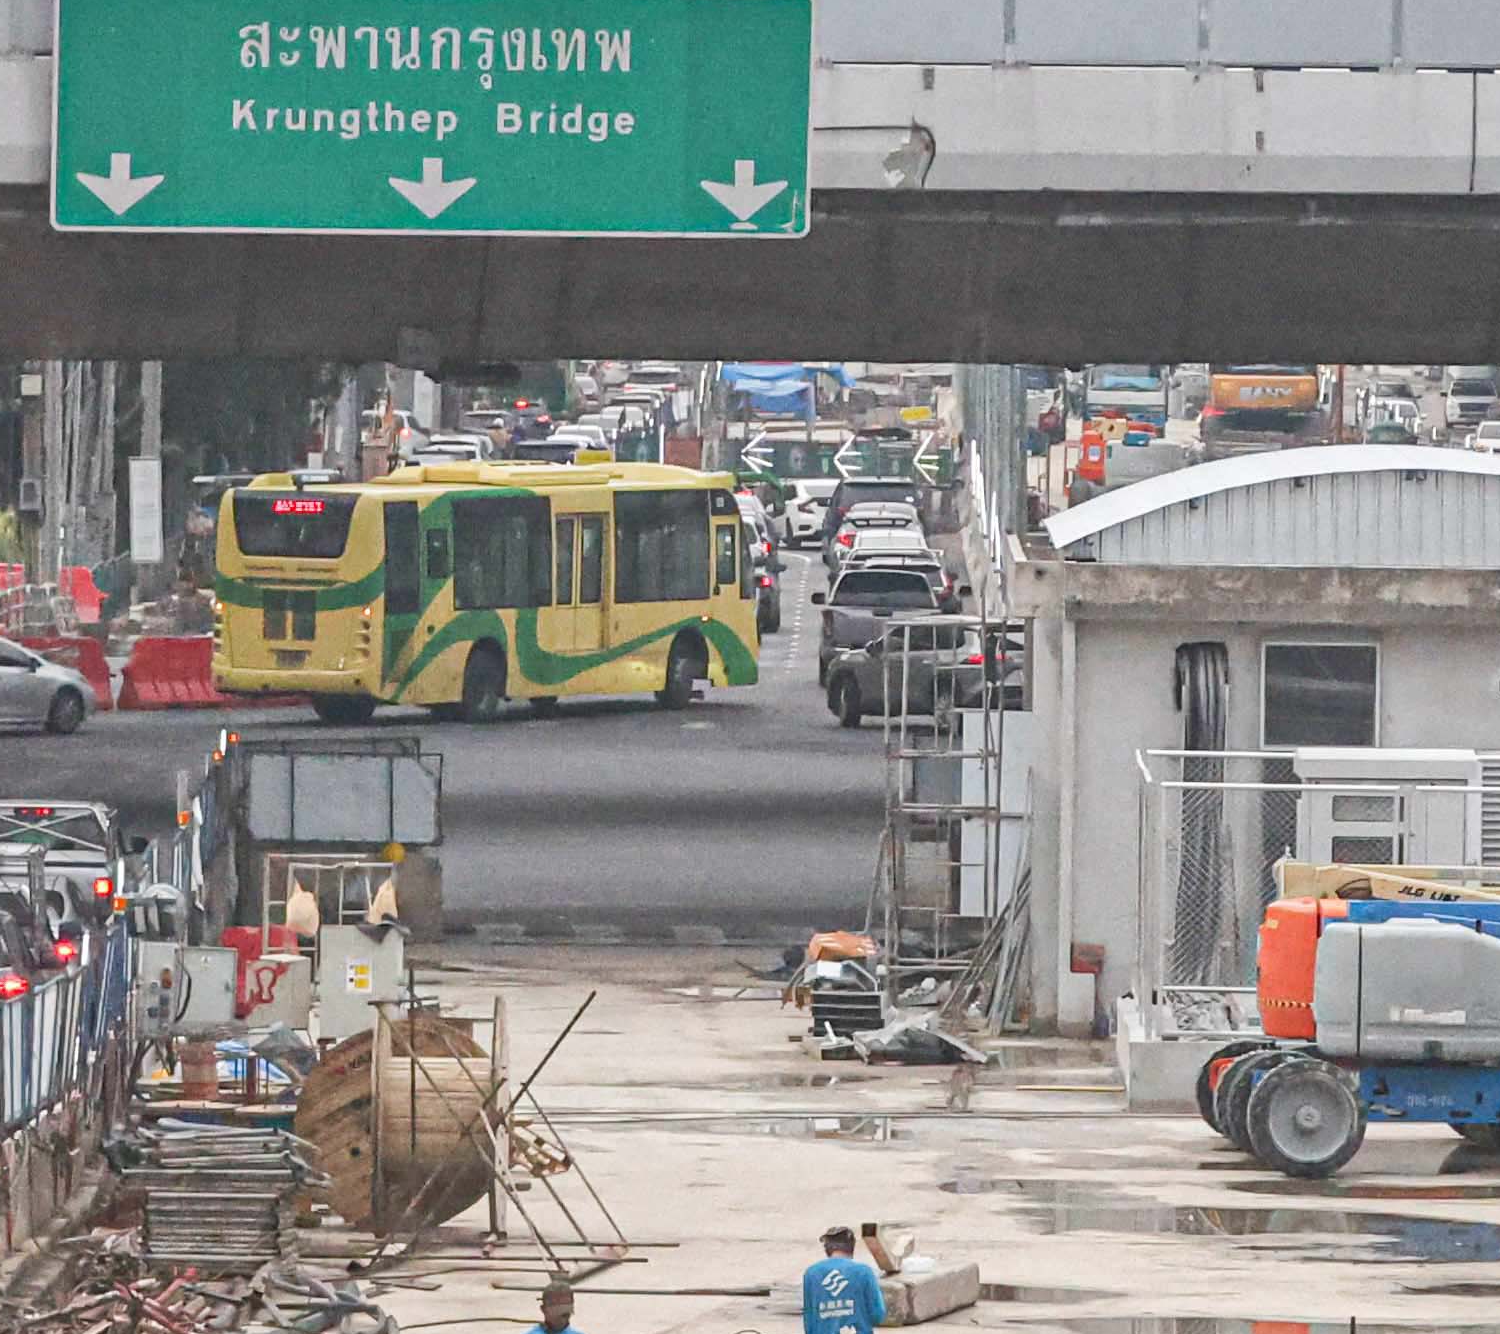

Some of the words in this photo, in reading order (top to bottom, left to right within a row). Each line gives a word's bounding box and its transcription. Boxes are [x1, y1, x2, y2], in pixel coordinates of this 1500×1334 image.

[238, 21, 632, 90] สะพานกรุงเทพ
[231, 98, 459, 141] Krungthep
[496, 102, 637, 142] Bridge
